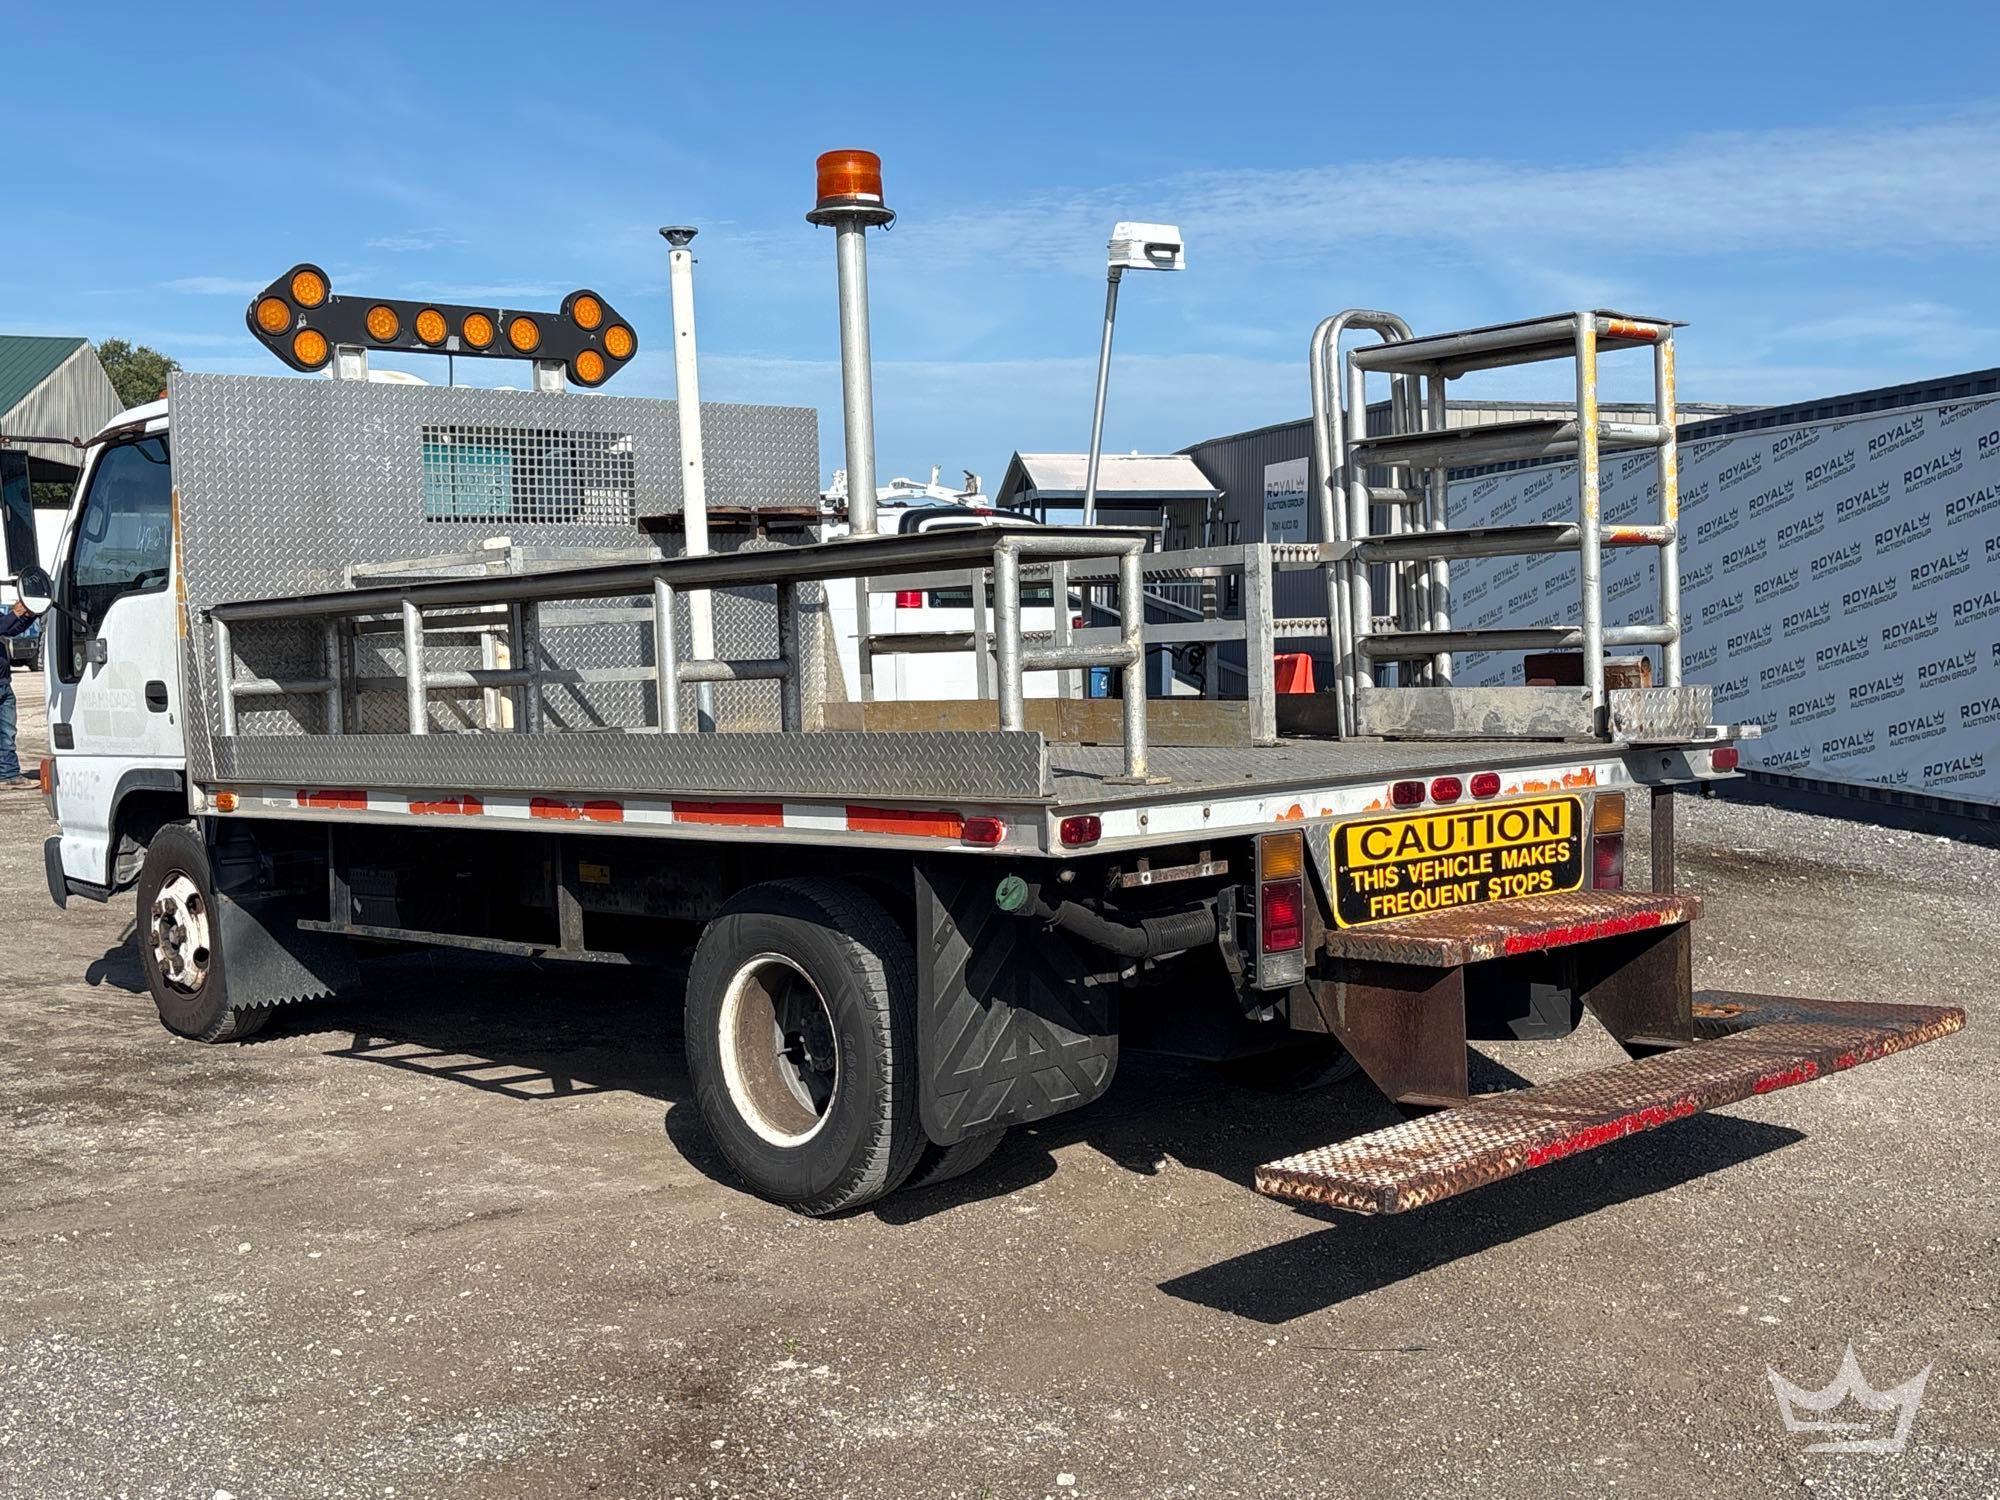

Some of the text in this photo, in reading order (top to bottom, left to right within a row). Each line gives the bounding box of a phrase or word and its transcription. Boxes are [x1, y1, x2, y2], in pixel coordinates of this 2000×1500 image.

[1940, 406, 1973, 426] AUCTION
[1772, 428, 1808, 455] ROYAL
[1869, 422, 1911, 452] ROYAL
[1718, 458, 1751, 484] ROYAL
[1806, 455, 1844, 483] ROYAL
[1904, 454, 1949, 484] ROYAL
[1905, 463, 1962, 493] AUCTION GROUP
[1473, 478, 1492, 498] ROYAL
[1524, 476, 1546, 497] ROYAL
[1491, 499, 1511, 519] ROYAL
[1749, 486, 1783, 511] ROYAL
[1837, 487, 1878, 514] ROYAL
[1946, 487, 1995, 517] ROYAL
[1542, 500, 1565, 521] ROYAL
[1604, 499, 1630, 521] ROYAL
[1948, 508, 1981, 526] AUCTION
[1697, 513, 1729, 536] ROYAL
[1777, 516, 1814, 542] ROYAL
[1875, 519, 1918, 546] ROYAL
[1723, 543, 1756, 566] ROYAL
[1812, 547, 1850, 572] ROYAL
[1494, 565, 1514, 583] ROYAL
[1680, 568, 1705, 586] OYAL
[1911, 554, 1956, 581] ROYAL
[1912, 564, 1970, 590] AUCTION GROUP
[1545, 570, 1568, 589] ROYAL
[1607, 575, 1634, 595] ROYAL
[1754, 573, 1789, 596] ROYAL
[1463, 583, 1482, 600] ROYAL
[1510, 590, 1532, 607] ROYAL
[1843, 582, 1884, 606] ROYAL
[1702, 596, 1734, 617] ROYAL
[1954, 590, 2000, 617] ROYAL
[1478, 607, 1498, 624] ROYAL
[1783, 606, 1820, 629] ROYAL
[1955, 611, 1988, 626] AUCTION
[1728, 628, 1762, 649] ROYAL
[1882, 616, 1926, 641] ROYAL
[1883, 627, 1938, 650] AUCTION GROUP
[1818, 640, 1857, 662] ROYAL
[1760, 661, 1795, 682] ROYAL
[1918, 655, 1964, 679] ROYAL
[1919, 666, 1977, 688] AUCTION GROUP
[1713, 681, 1740, 697] OYAL
[1850, 677, 1891, 699] ROYAL
[1789, 696, 1826, 717] ROYAL
[1961, 695, 2000, 718] ROYA
[1888, 715, 1933, 737] ROYAL
[1962, 715, 1996, 728] AUCTION
[1824, 733, 1863, 753] ROYAL
[1890, 726, 1945, 746] AUCTION GROUP
[1762, 750, 1799, 767] ROYAL
[1925, 757, 1971, 778] ROYAL
[1926, 769, 1985, 787] AUCTION GROUP
[1360, 806, 1560, 861] CAUTION
[1350, 843, 1570, 893] THIS VEHICLE MAKES
[1370, 871, 1553, 917] FREQUENT STOPS
